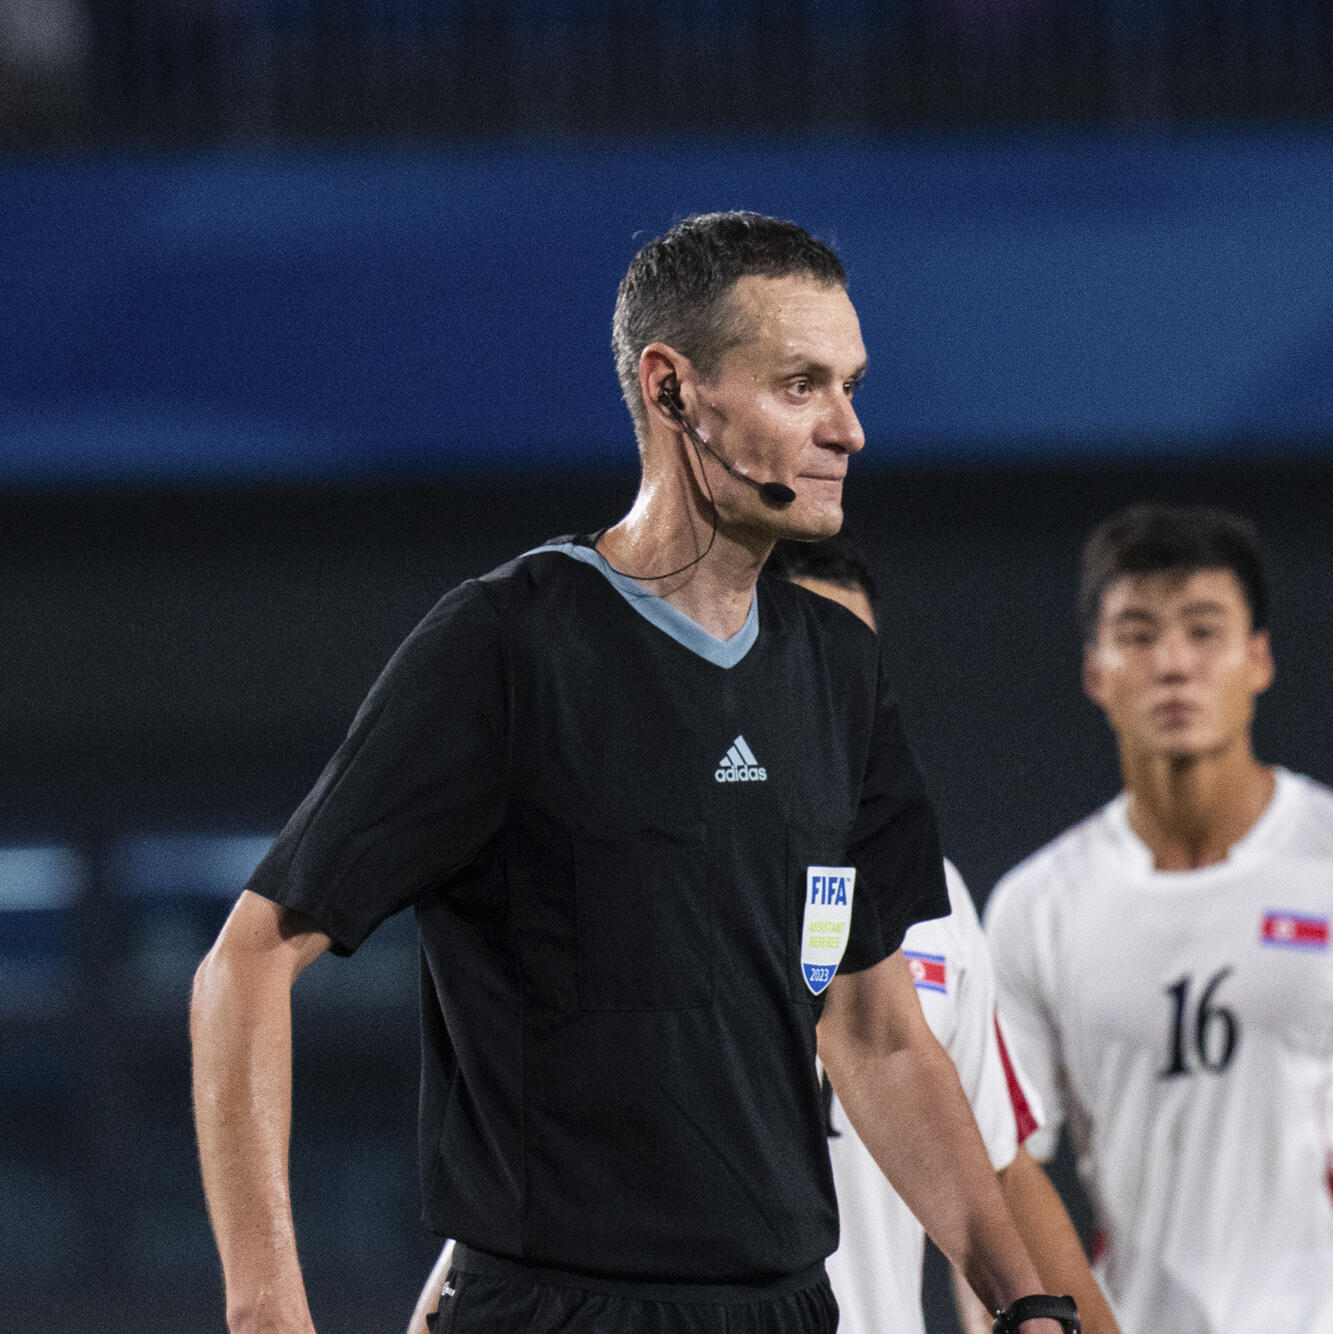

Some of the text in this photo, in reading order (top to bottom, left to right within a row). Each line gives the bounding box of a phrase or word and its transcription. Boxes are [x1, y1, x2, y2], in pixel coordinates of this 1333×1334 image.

[715, 764, 767, 783] adidas
[811, 876, 848, 906] FIFA
[809, 967, 830, 983] 2023
[1157, 966, 1241, 1080] 16
